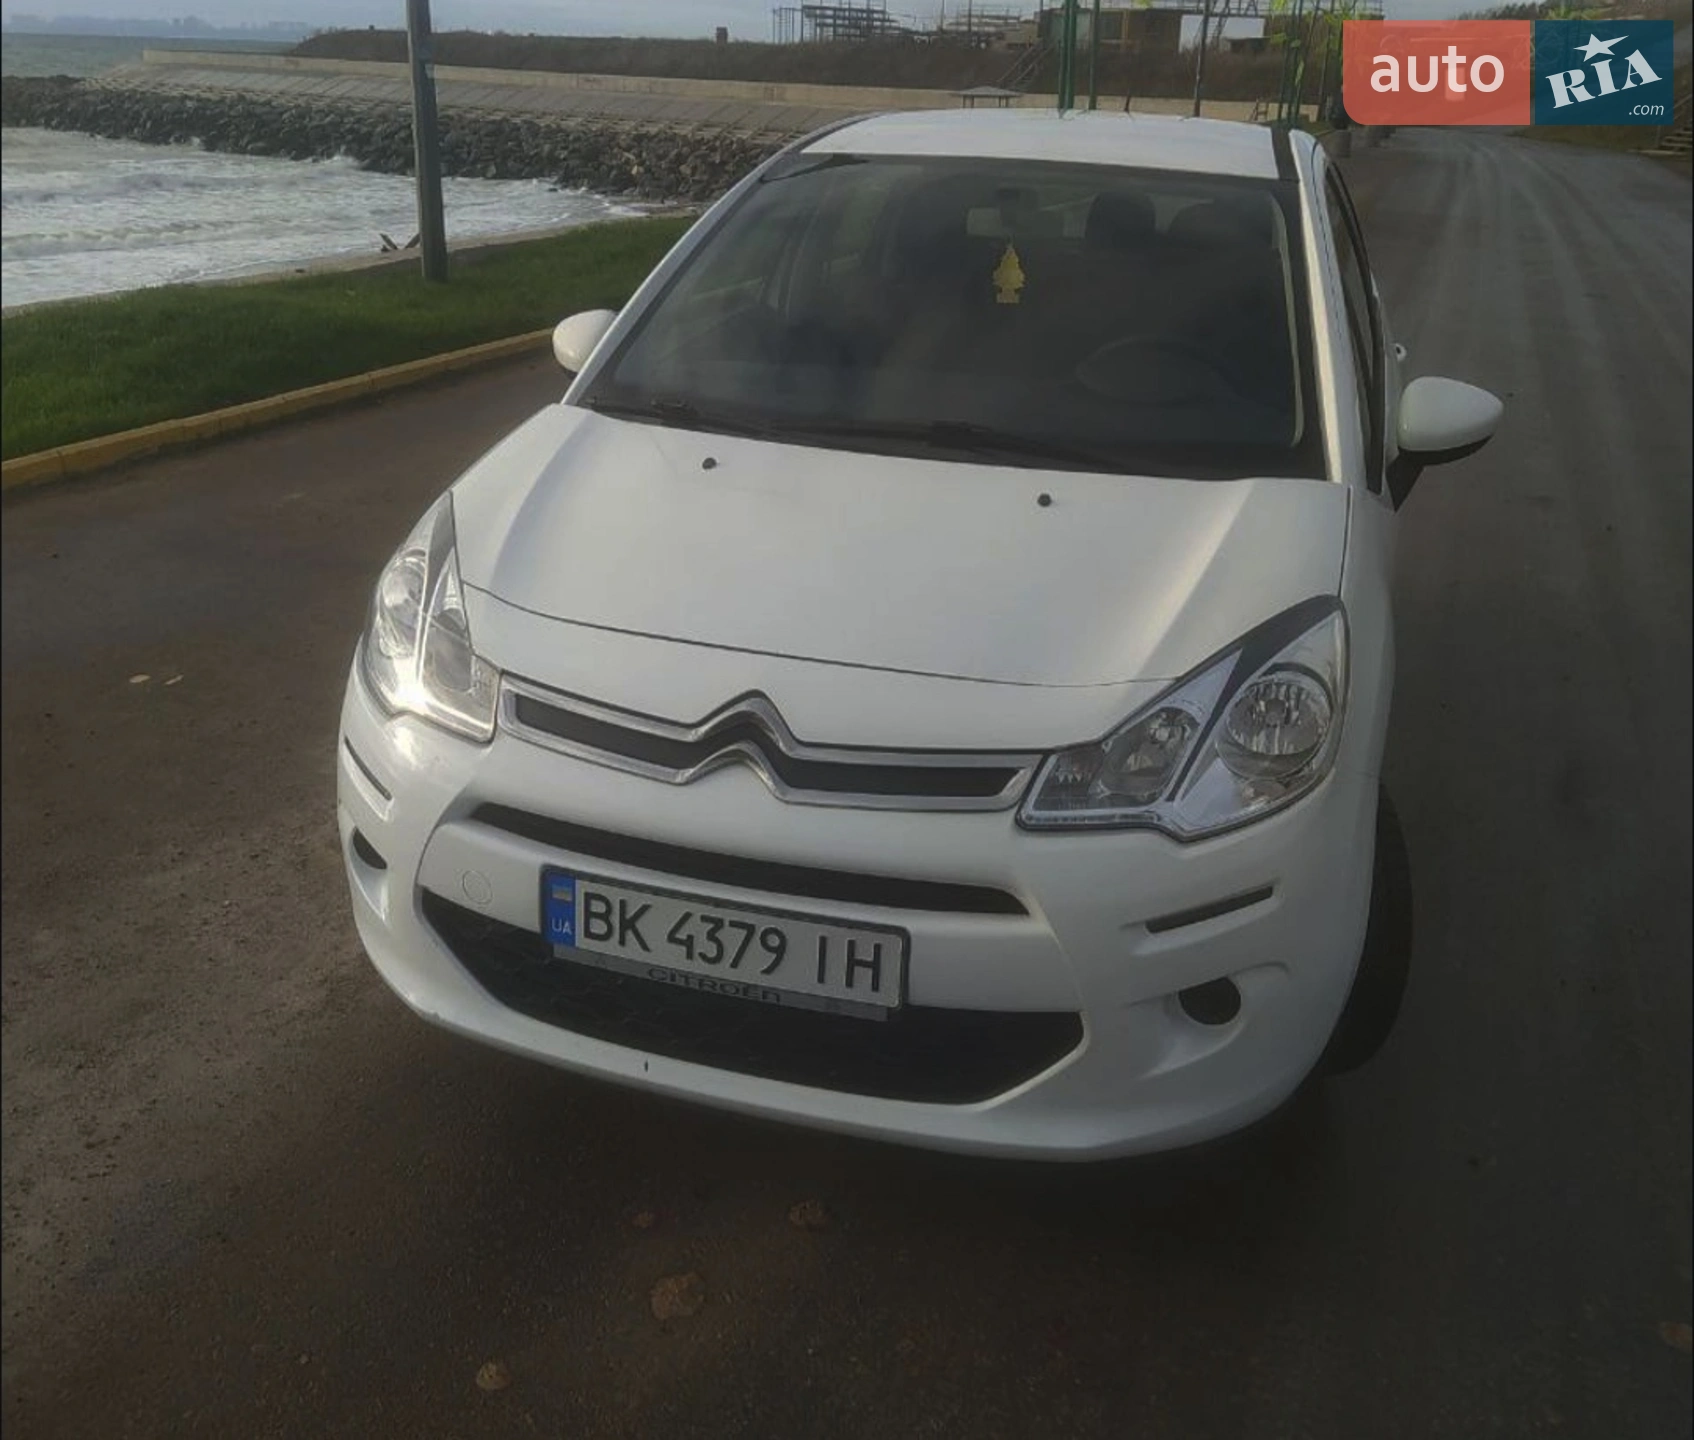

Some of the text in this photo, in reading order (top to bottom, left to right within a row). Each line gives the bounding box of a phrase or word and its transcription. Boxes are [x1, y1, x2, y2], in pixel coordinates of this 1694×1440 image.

[552, 918, 572, 935] UA
[582, 891, 882, 992] BK 4379 IH
